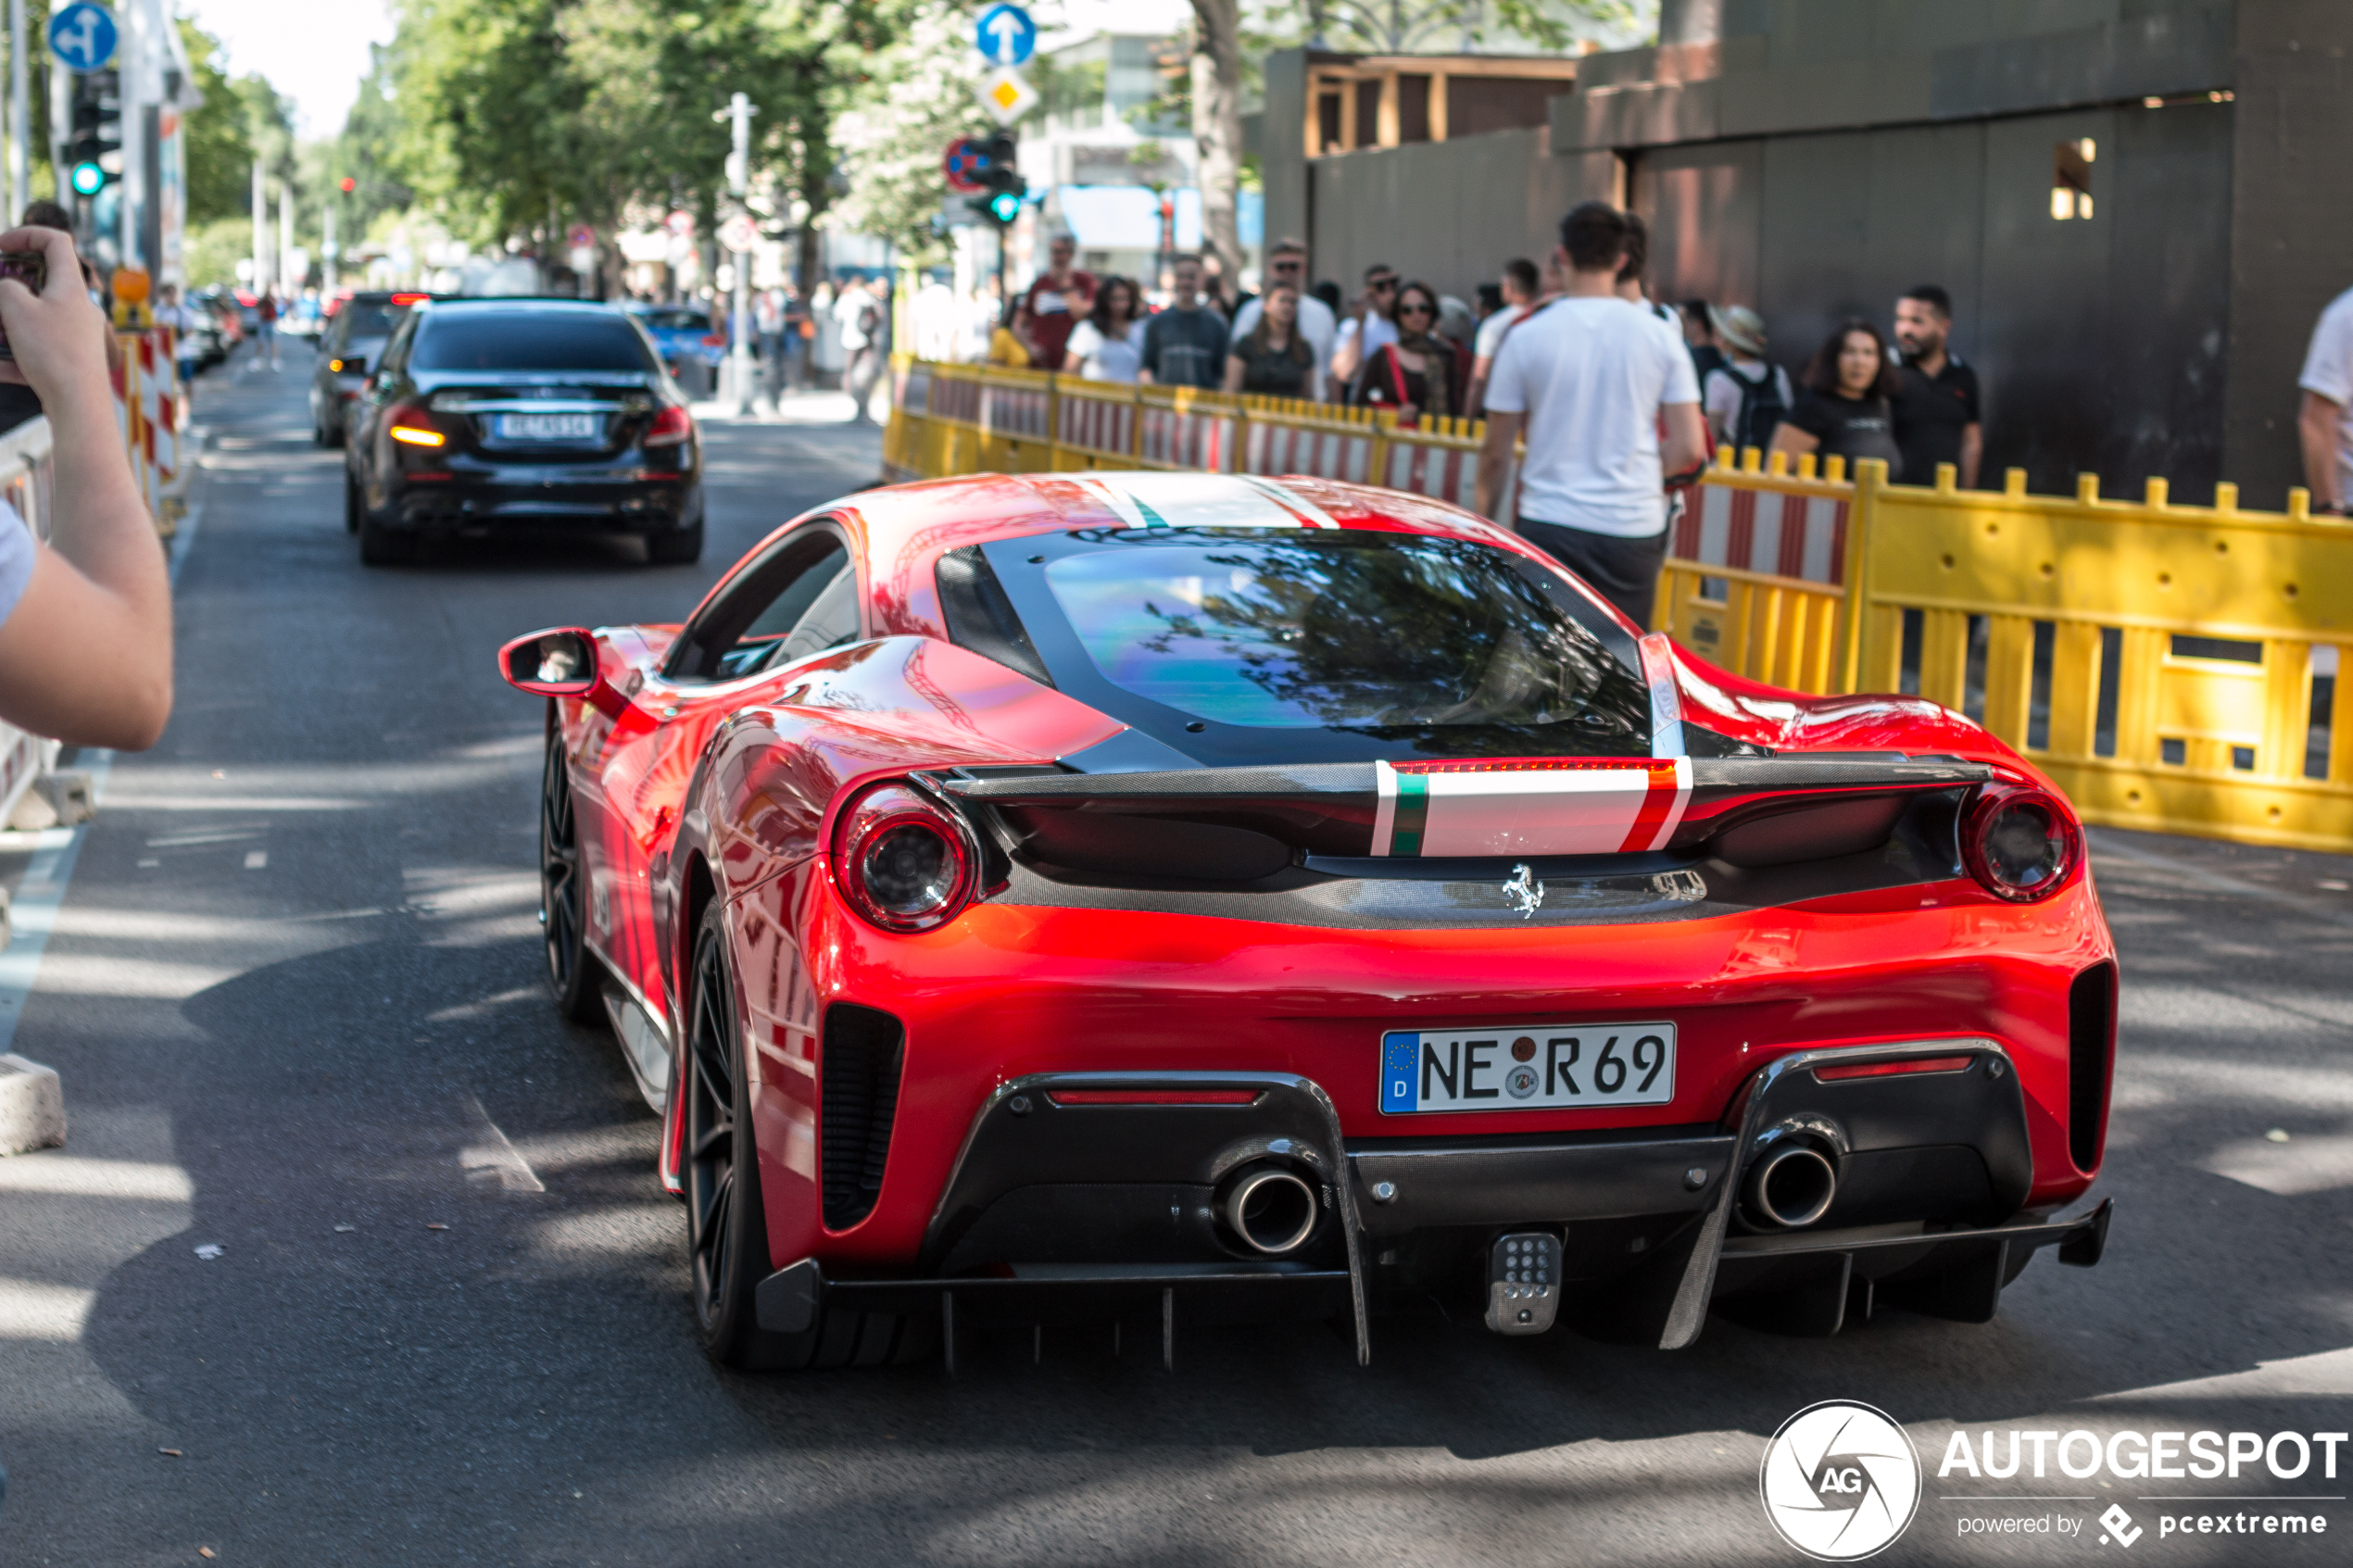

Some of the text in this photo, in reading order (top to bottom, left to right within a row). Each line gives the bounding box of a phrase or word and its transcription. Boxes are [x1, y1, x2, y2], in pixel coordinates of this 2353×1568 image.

[1393, 1080, 1407, 1098] D
[1421, 1040, 1500, 1101] NE
[1545, 1037, 1581, 1096] R
[1593, 1035, 1666, 1094] 69
